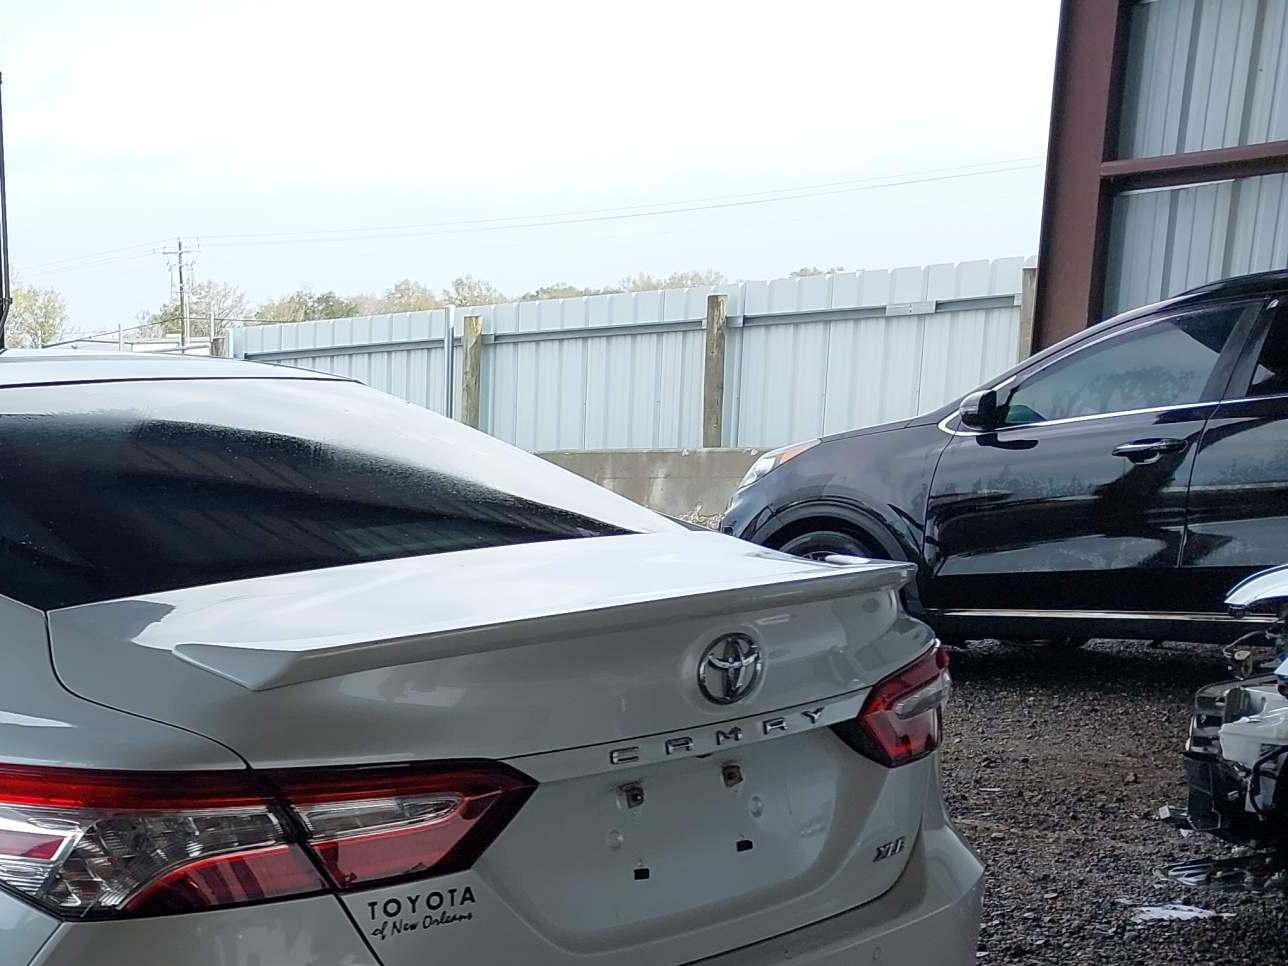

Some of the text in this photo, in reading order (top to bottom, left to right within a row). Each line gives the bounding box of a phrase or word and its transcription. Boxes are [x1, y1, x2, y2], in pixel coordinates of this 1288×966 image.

[610, 707, 825, 765] CAMRY
[367, 886, 476, 920] TOYOTA
[371, 910, 473, 941] of New Orleans
